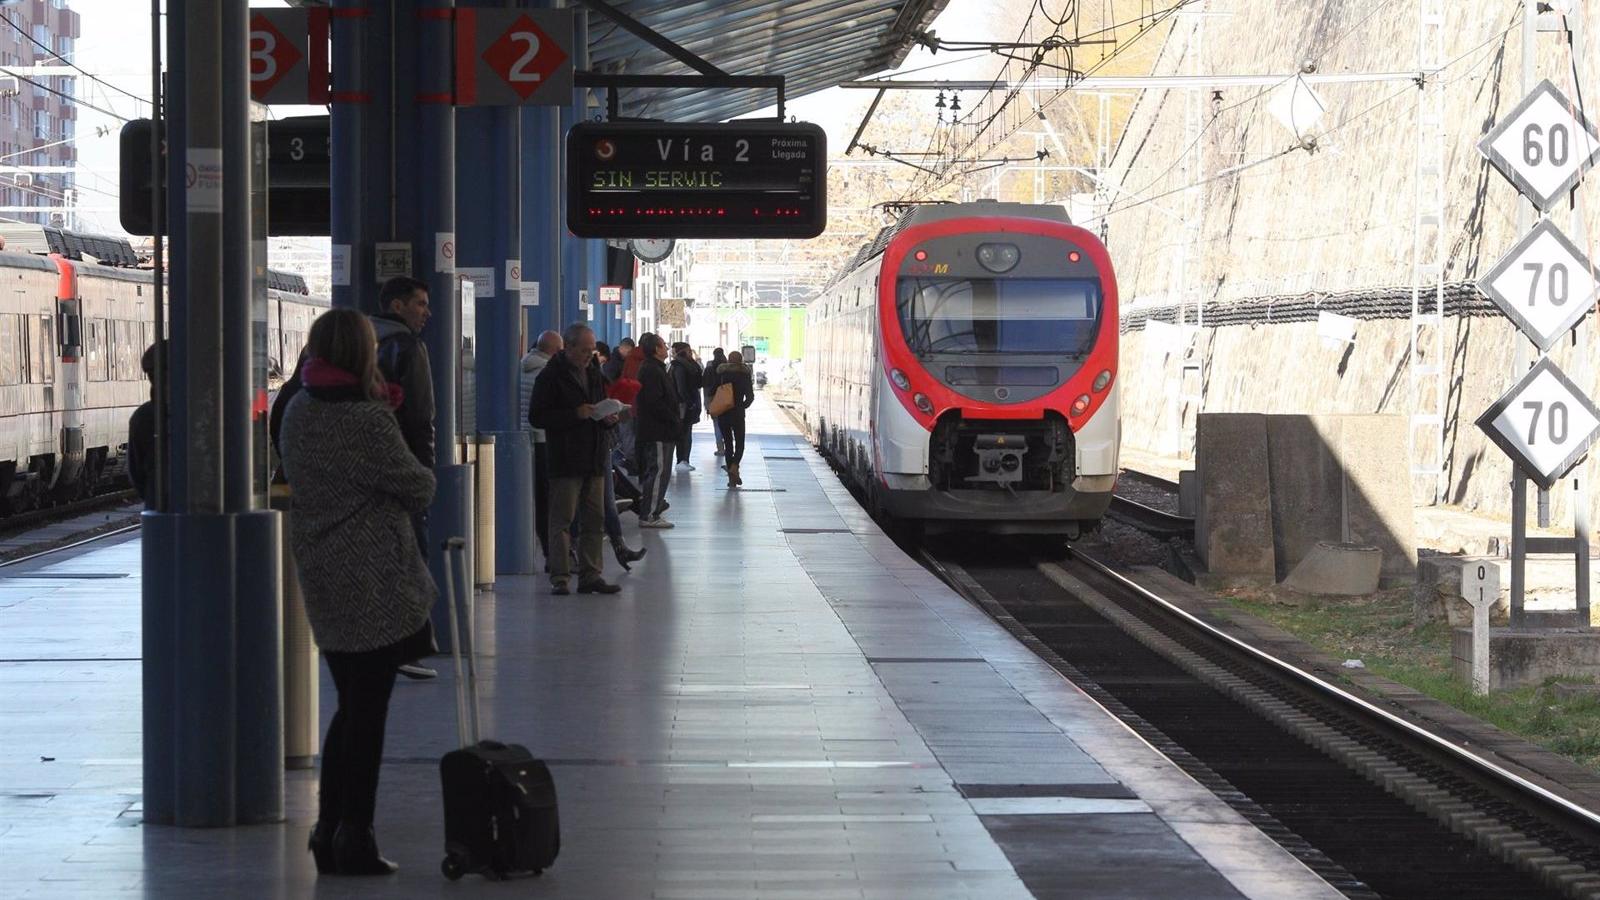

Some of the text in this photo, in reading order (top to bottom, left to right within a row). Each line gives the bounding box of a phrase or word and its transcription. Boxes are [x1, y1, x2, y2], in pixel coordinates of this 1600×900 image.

[508, 32, 541, 82] 2
[291, 138, 304, 160] 3
[657, 138, 750, 162] Vía 2
[772, 149, 806, 160] Llegada
[1522, 122, 1569, 167] 60
[593, 171, 722, 187] SIN SERVIC
[932, 263, 949, 273] M
[1522, 262, 1569, 307] 70
[1522, 400, 1569, 446] 70
[1477, 565, 1486, 580] 0
